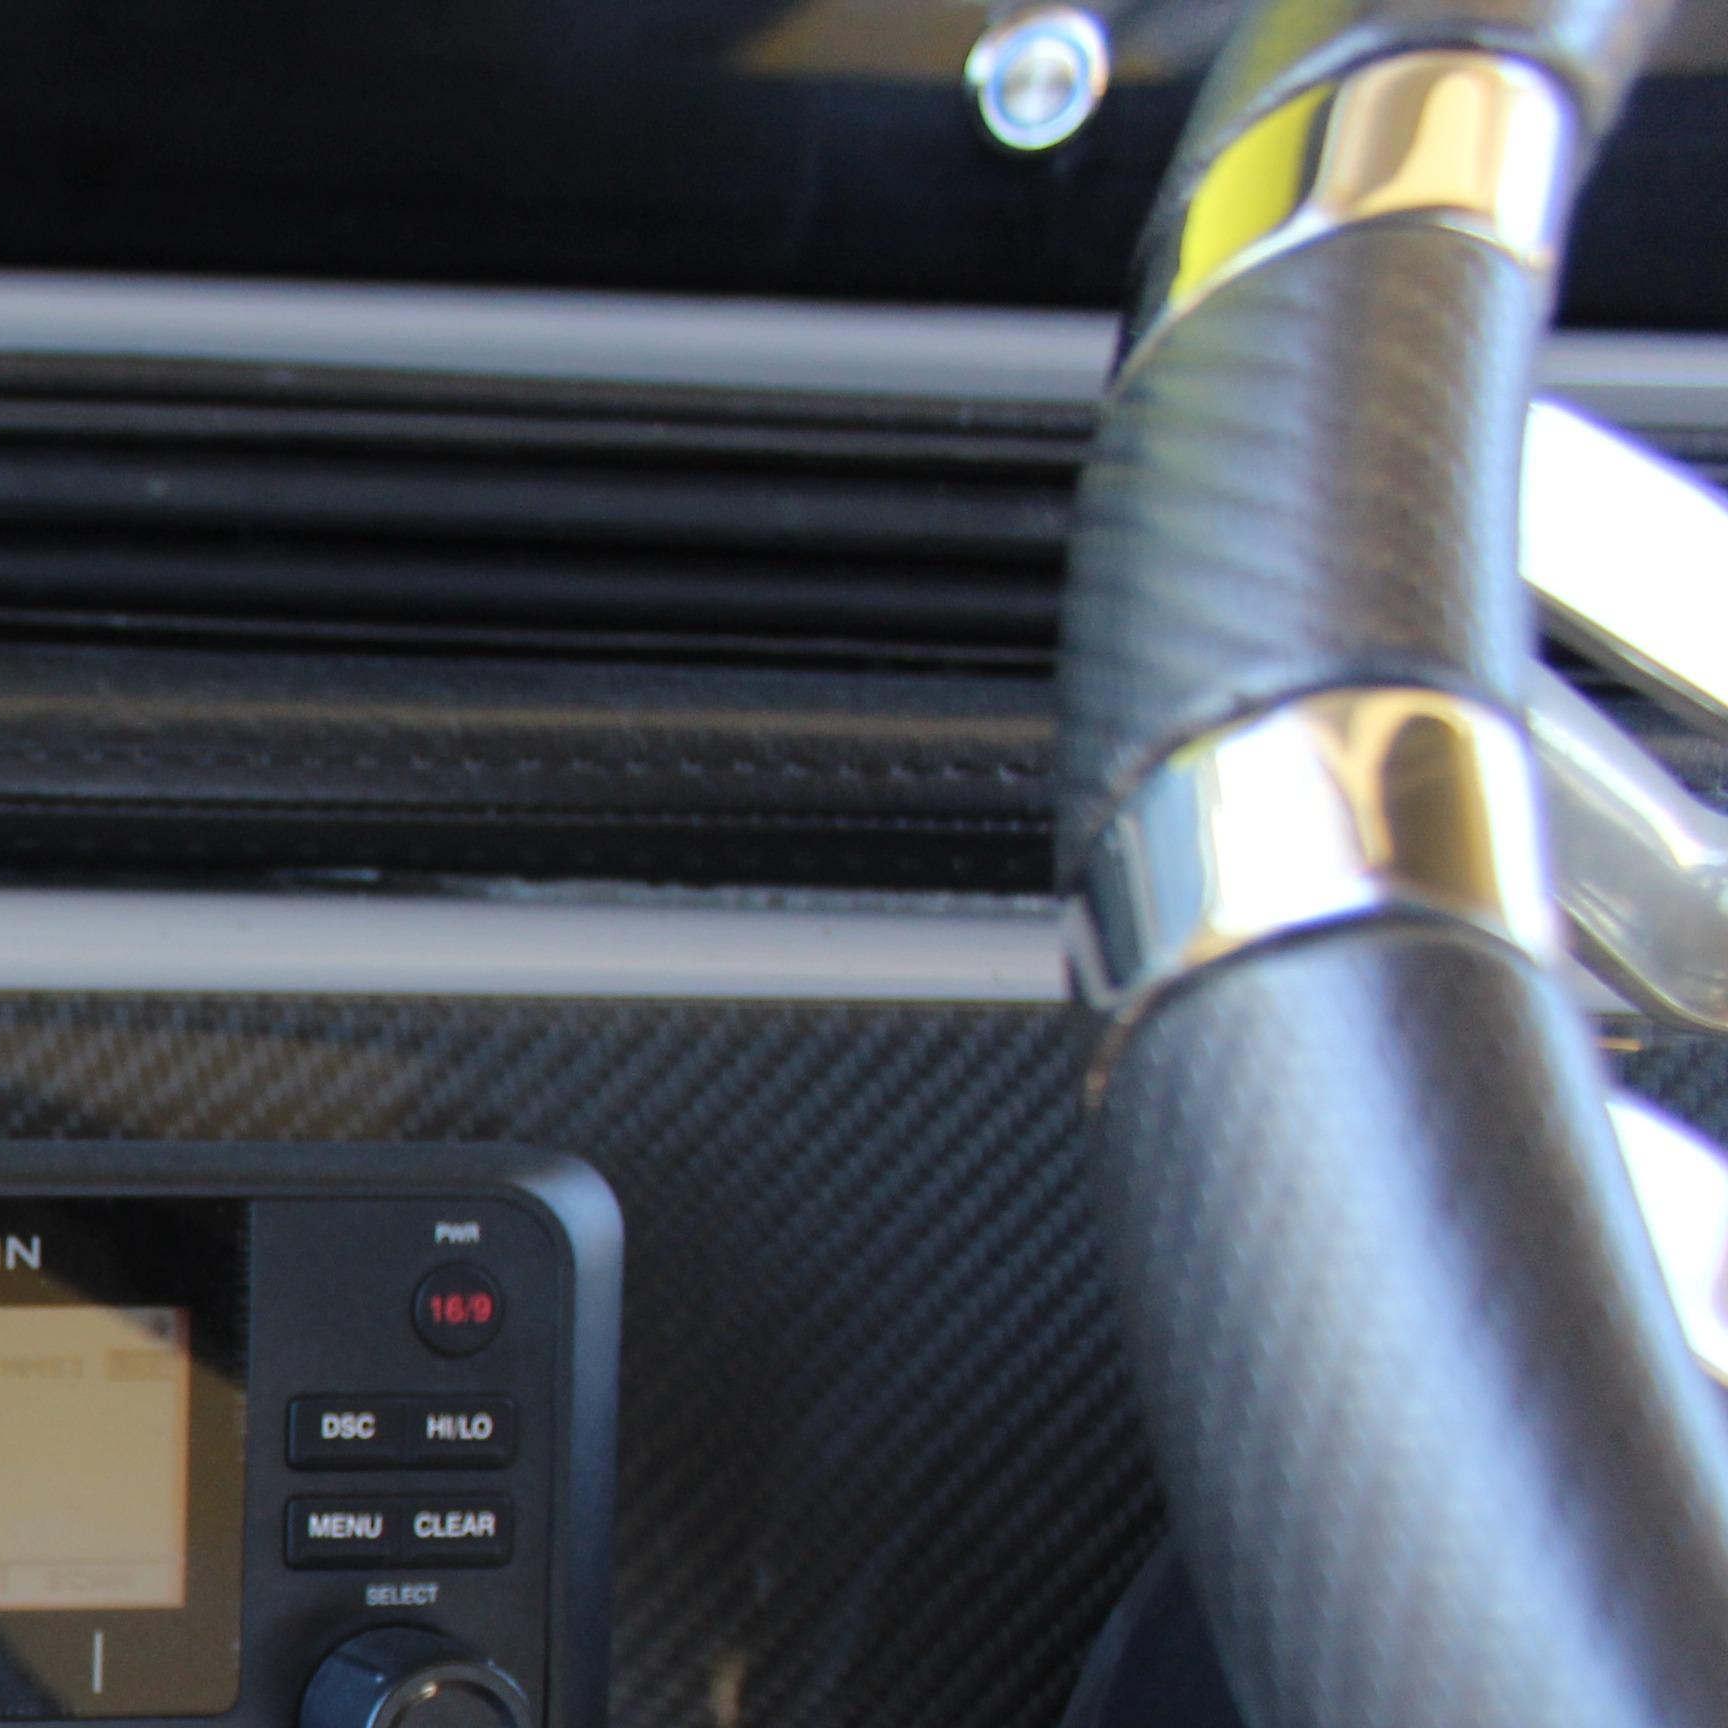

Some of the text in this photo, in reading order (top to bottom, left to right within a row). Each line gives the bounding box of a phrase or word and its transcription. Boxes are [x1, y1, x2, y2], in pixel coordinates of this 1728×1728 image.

[435, 1223, 480, 1244] PWR
[429, 1294, 493, 1325] 16/9
[321, 1414, 376, 1439] DSC
[426, 1413, 493, 1440] HI/LO
[308, 1513, 383, 1539] MENU
[414, 1511, 496, 1538] CLEAR
[366, 1585, 438, 1605] SELECT
